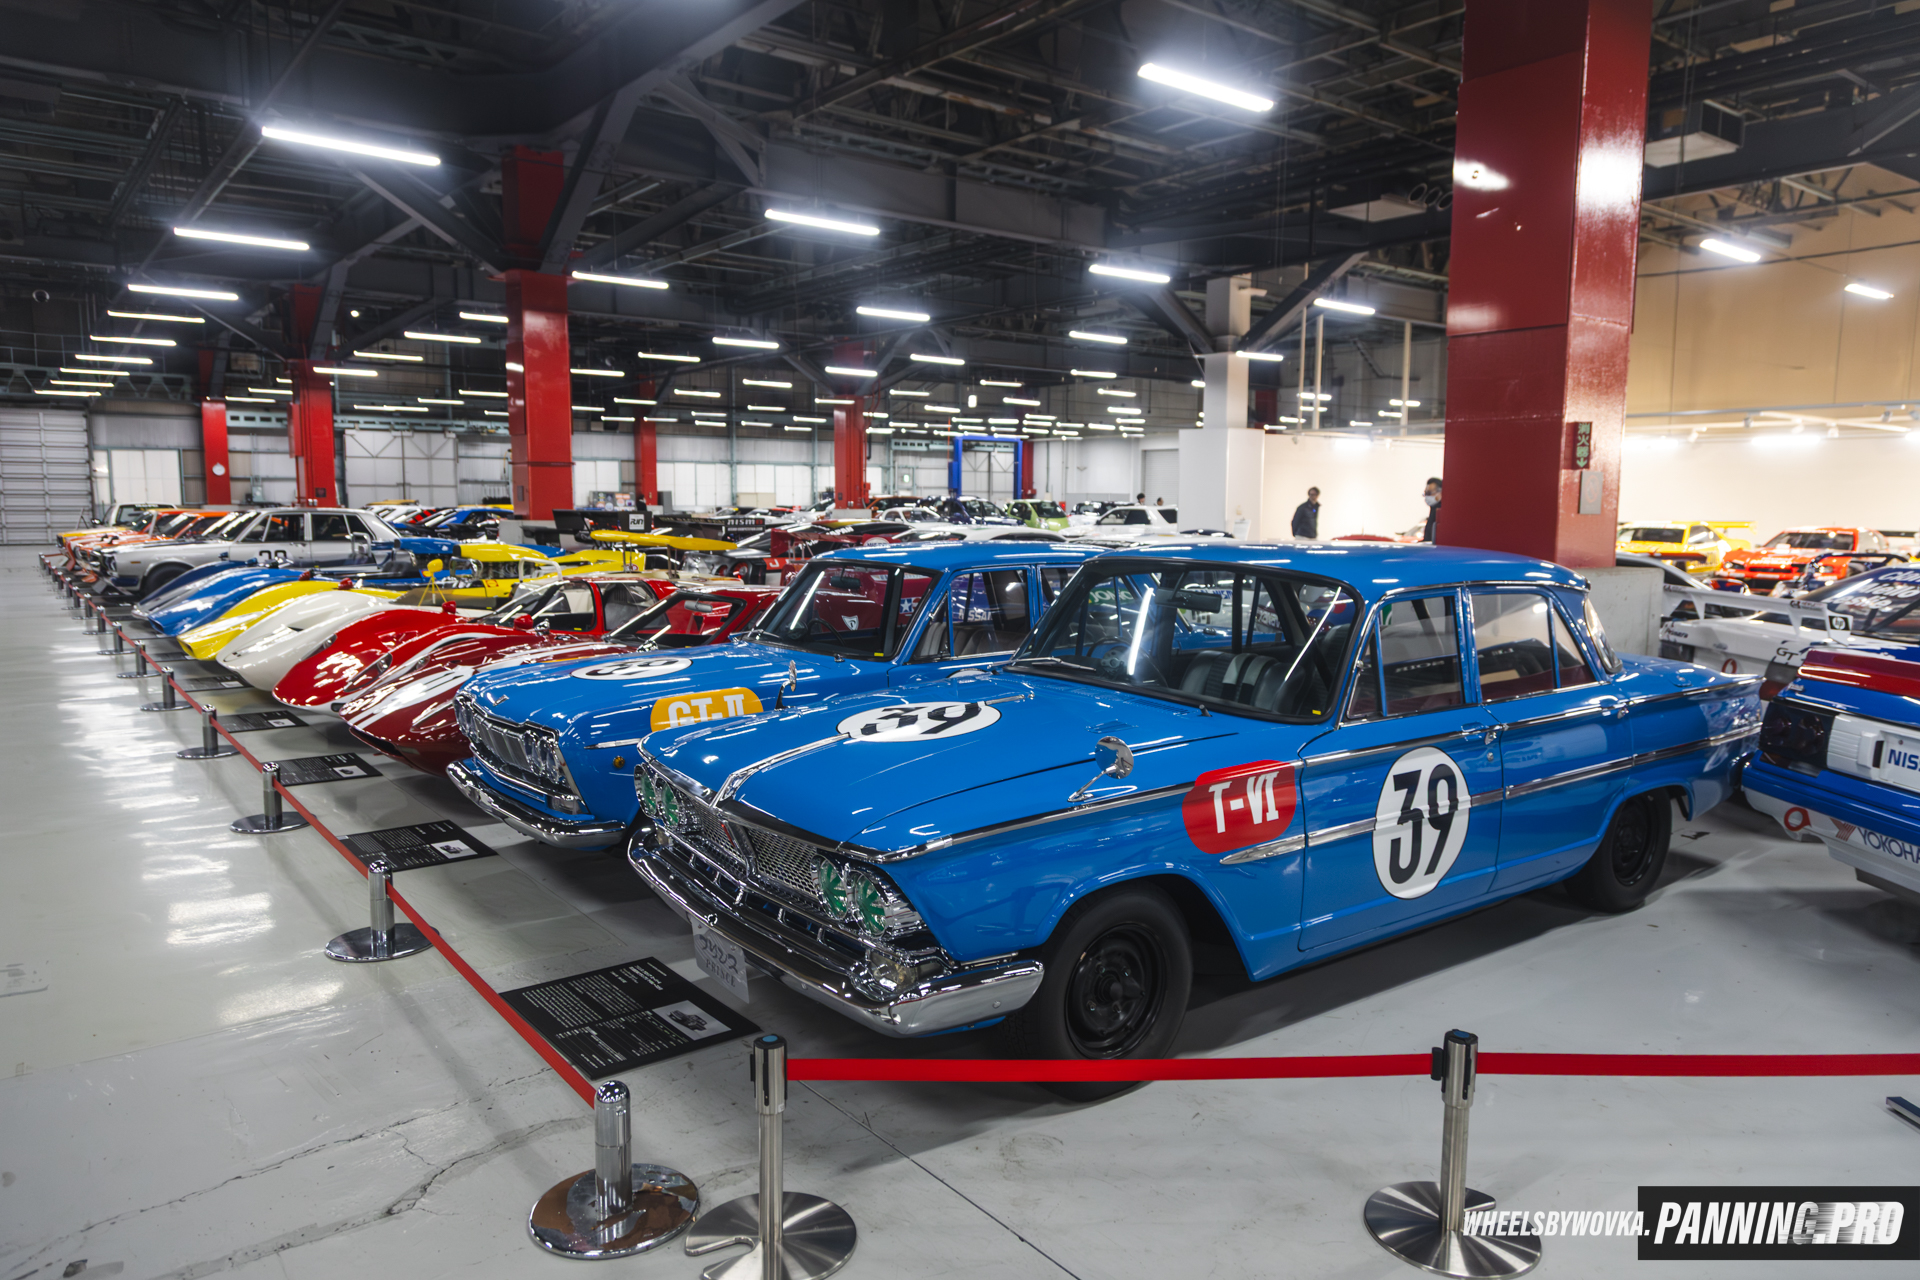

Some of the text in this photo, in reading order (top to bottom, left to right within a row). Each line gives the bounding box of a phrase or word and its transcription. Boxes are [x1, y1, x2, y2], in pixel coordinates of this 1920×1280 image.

[1576, 423, 1591, 458] 消火器
[958, 608, 993, 622] NSSA
[1776, 647, 1799, 662] GT
[860, 702, 982, 736] 39
[1887, 748, 1920, 772] NIS
[1388, 763, 1459, 885] 39
